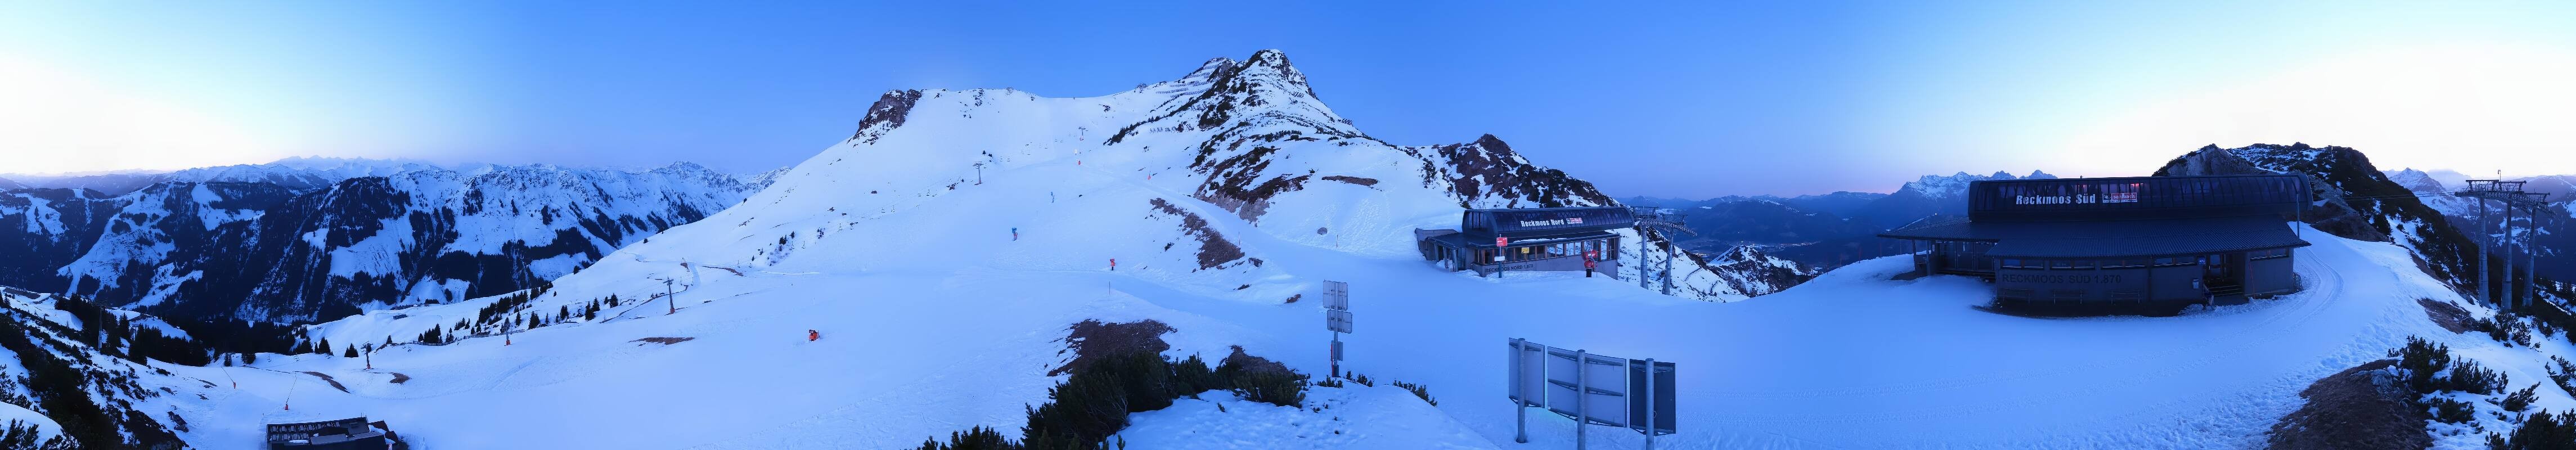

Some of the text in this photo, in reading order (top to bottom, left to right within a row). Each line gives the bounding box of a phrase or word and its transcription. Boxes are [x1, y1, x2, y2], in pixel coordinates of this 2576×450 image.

[2016, 194, 2096, 205] Reckmoos Süd
[2002, 274, 2064, 284] RECKMOOS
[2094, 274, 2121, 284] 1.870
